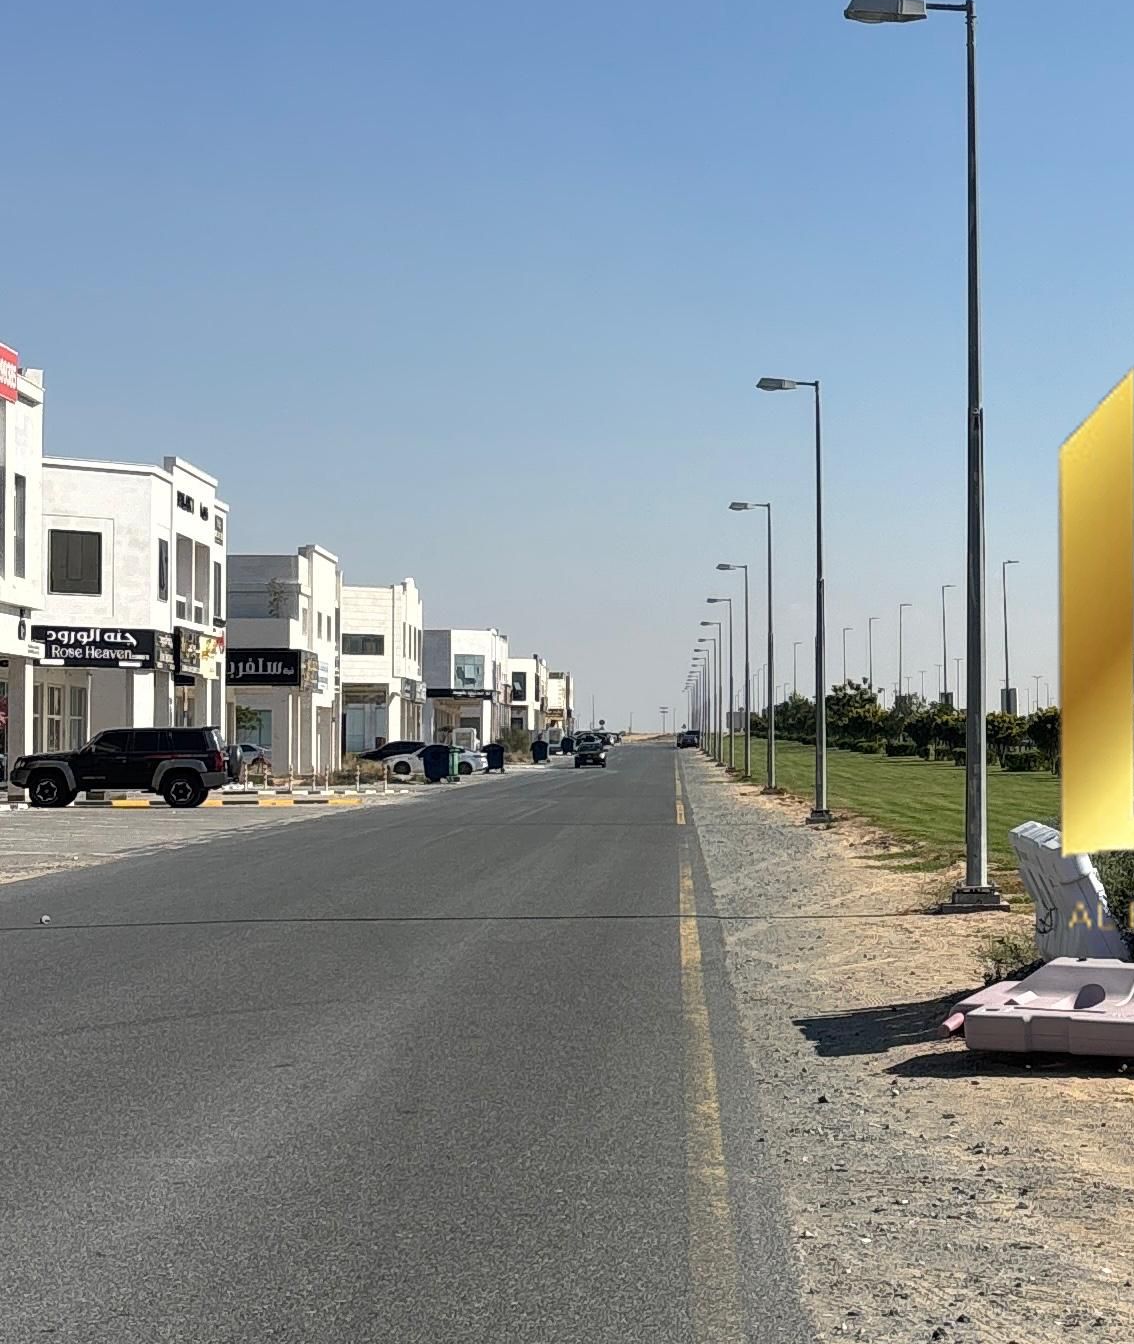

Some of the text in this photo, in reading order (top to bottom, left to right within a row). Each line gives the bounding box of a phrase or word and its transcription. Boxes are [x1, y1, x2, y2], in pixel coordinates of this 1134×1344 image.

[46, 629, 100, 645] الورود
[51, 645, 83, 659] Rose
[85, 646, 132, 659] Heaven
